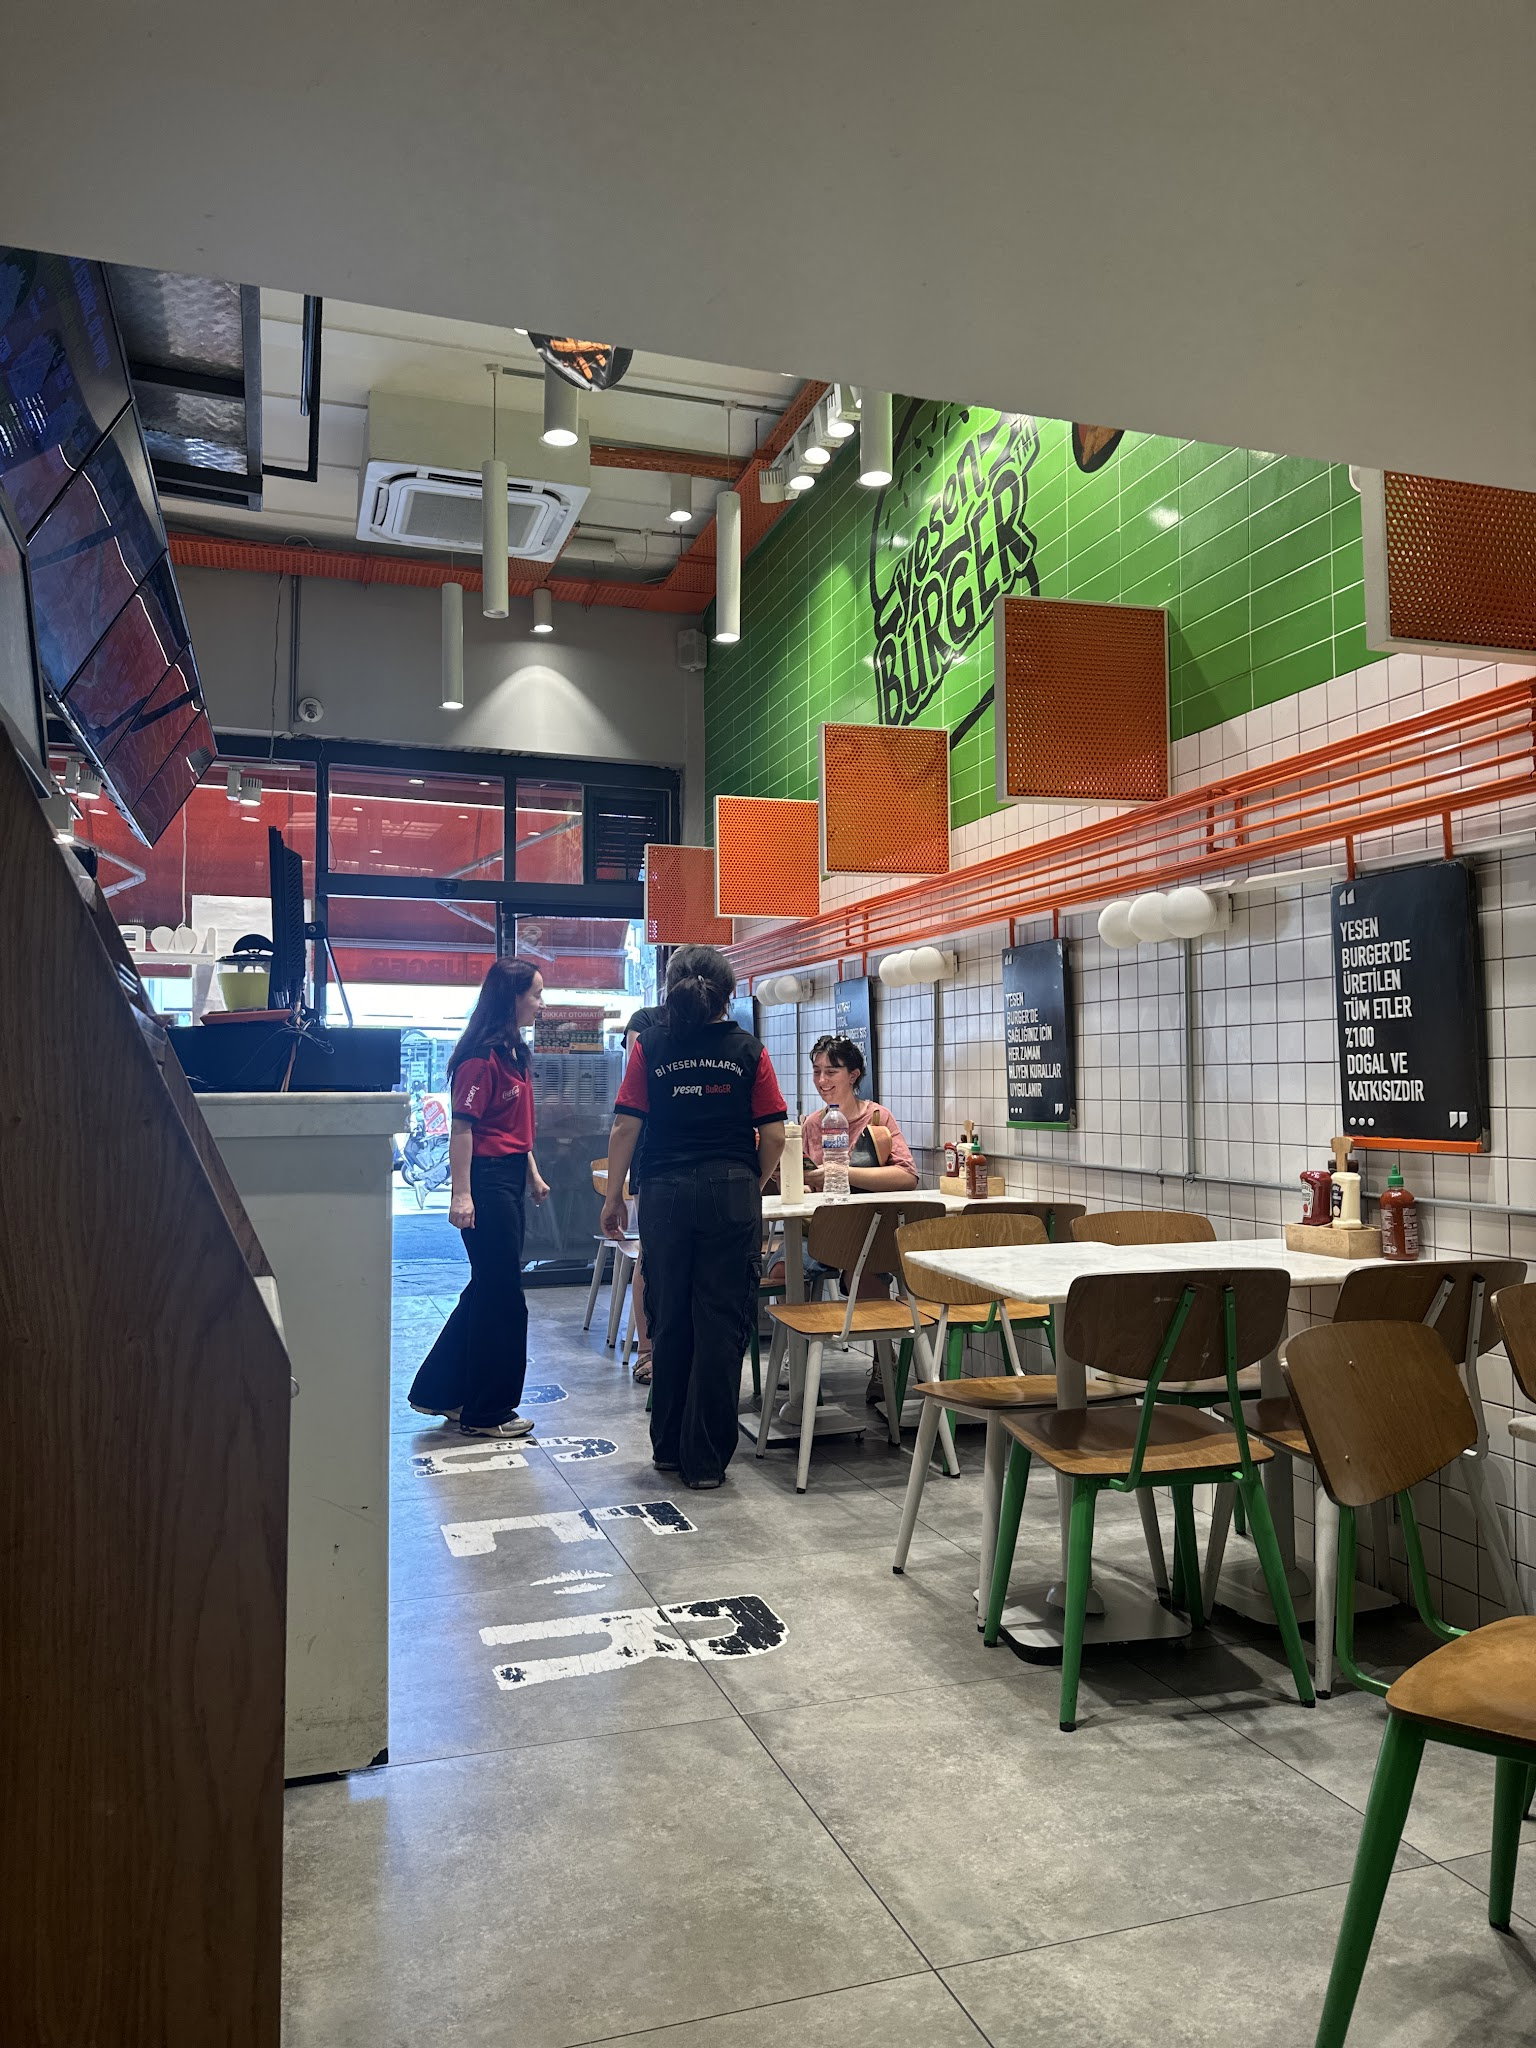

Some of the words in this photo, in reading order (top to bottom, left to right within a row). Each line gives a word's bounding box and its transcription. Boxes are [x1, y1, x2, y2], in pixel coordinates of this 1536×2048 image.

[886, 438, 987, 639] yesen
[879, 469, 1029, 725] BURGER
[1340, 917, 1379, 942] YESEN
[1342, 939, 1412, 968] BURGER'DE
[1343, 968, 1401, 995] ÜRETİLEN
[1005, 991, 1024, 1007] YESEN
[1344, 997, 1370, 1022] TÜM
[1373, 996, 1413, 1020] ETLER
[1345, 1026, 1375, 1048] %100
[1008, 1047, 1021, 1061] HER
[1020, 1046, 1041, 1060] ZAMAN
[1390, 1051, 1408, 1074] VE
[666, 1059, 697, 1073] YESEN
[699, 1058, 744, 1077] ANLARSIN
[1029, 1063, 1062, 1078] KURALLAR
[464, 1085, 480, 1110] yesen
[671, 1085, 703, 1098] yesen
[1009, 1082, 1043, 1098] UYGULANIR
[1348, 1079, 1425, 1102] KATKISIZDIR
